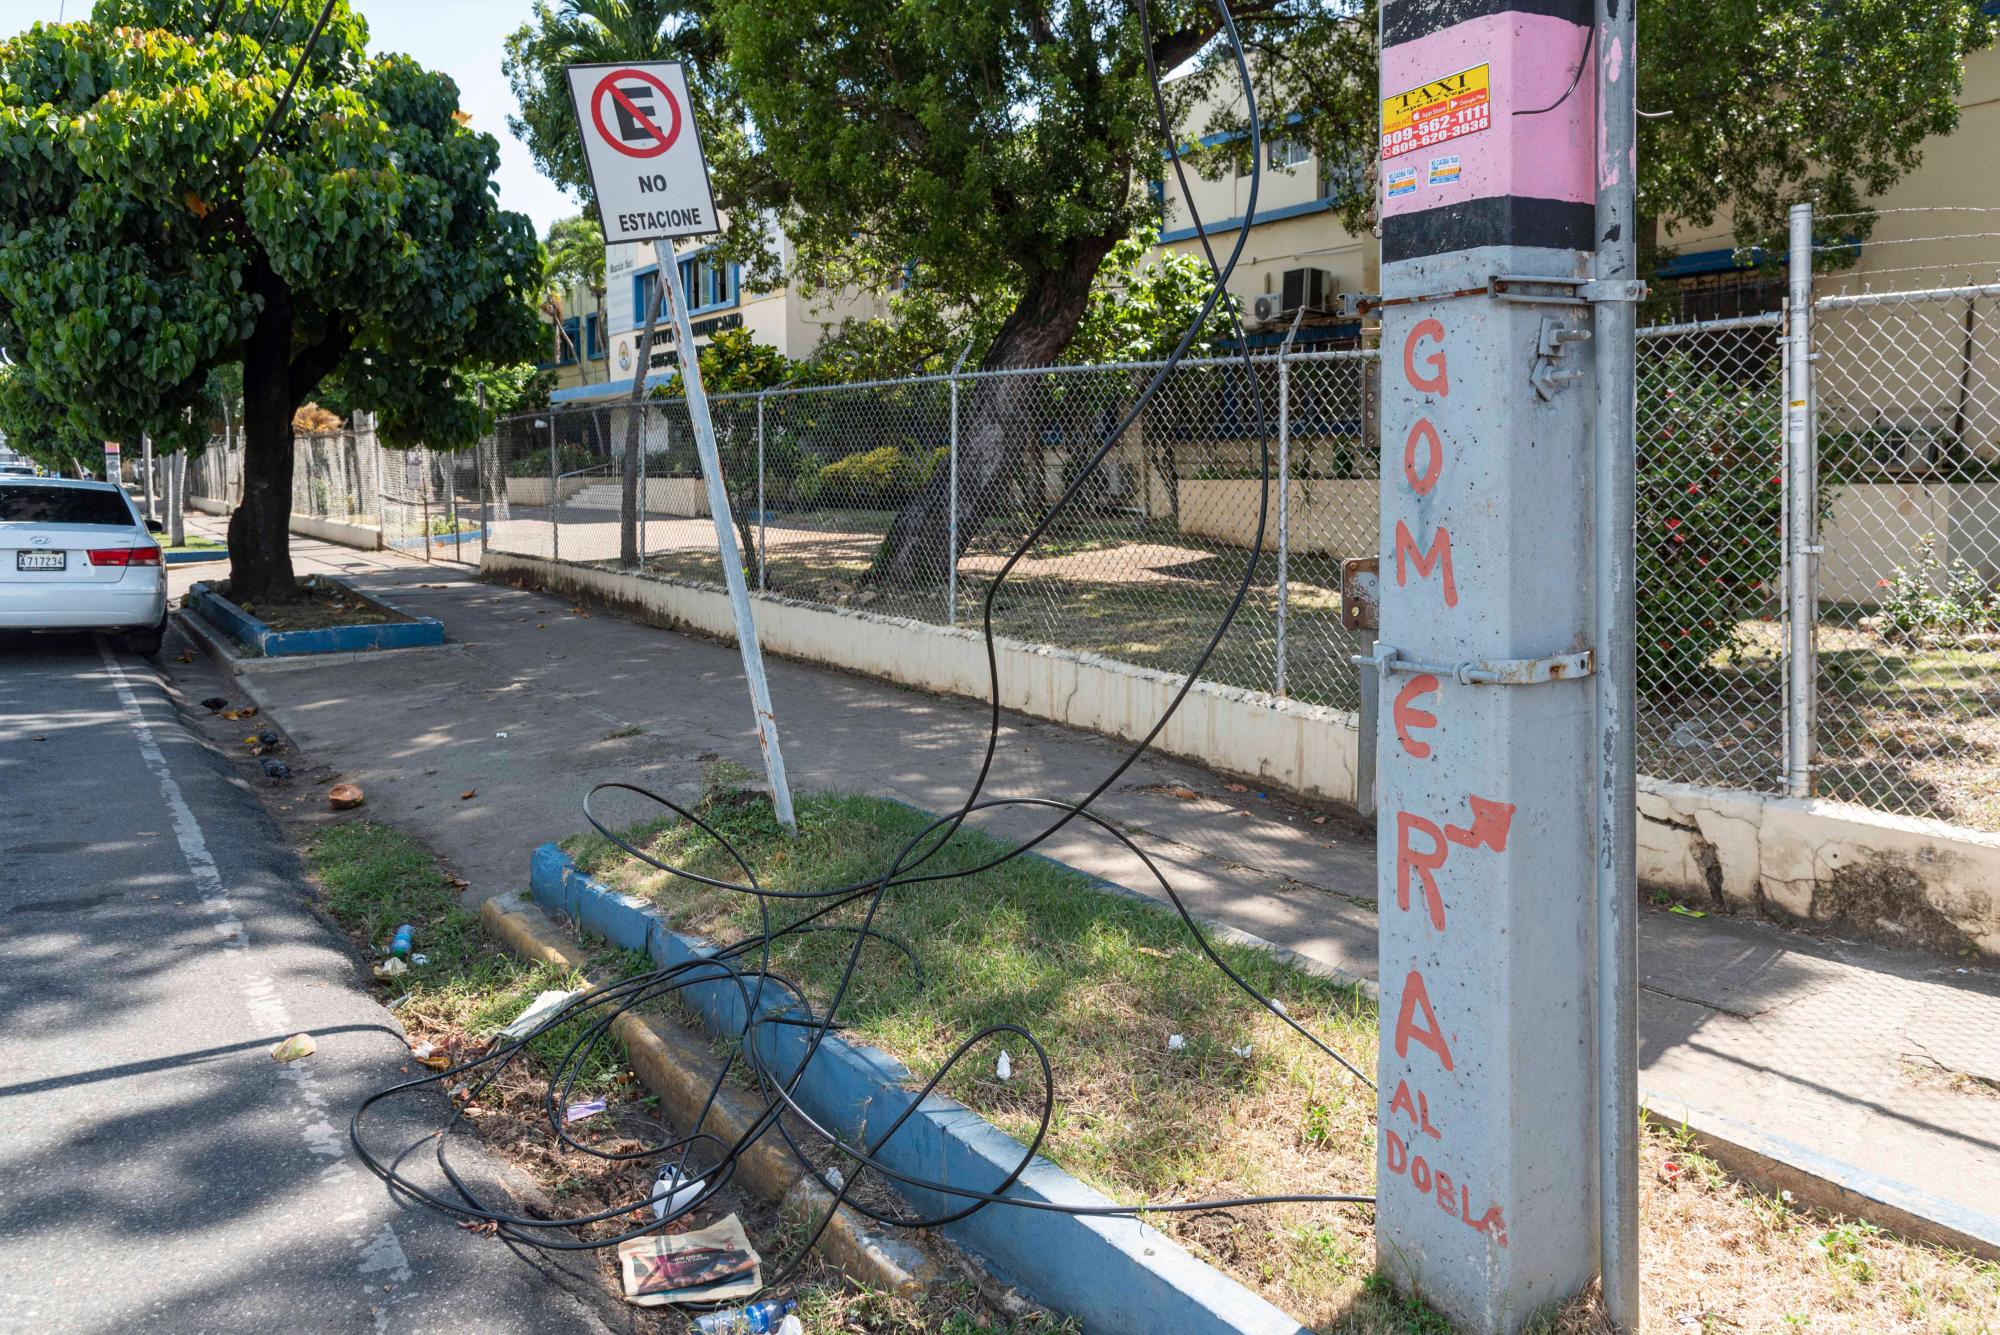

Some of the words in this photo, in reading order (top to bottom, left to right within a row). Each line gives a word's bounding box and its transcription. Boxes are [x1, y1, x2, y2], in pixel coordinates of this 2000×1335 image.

[1395, 74, 1467, 107] TAXI
[1396, 103, 1423, 114] Lope
[1426, 97, 1439, 105] de
[1444, 87, 1471, 98] Vega
[1459, 97, 1476, 107] Google
[1383, 102, 1489, 147] 809-562-1111
[1422, 111, 1433, 119] App
[1433, 106, 1446, 115] Store
[1391, 117, 1489, 155] 809-620-3838
[638, 174, 667, 193] NO
[618, 208, 702, 232] ESTACIONE
[1392, 318, 1458, 1072] GOMERA
[1391, 1079, 1441, 1139] AL
